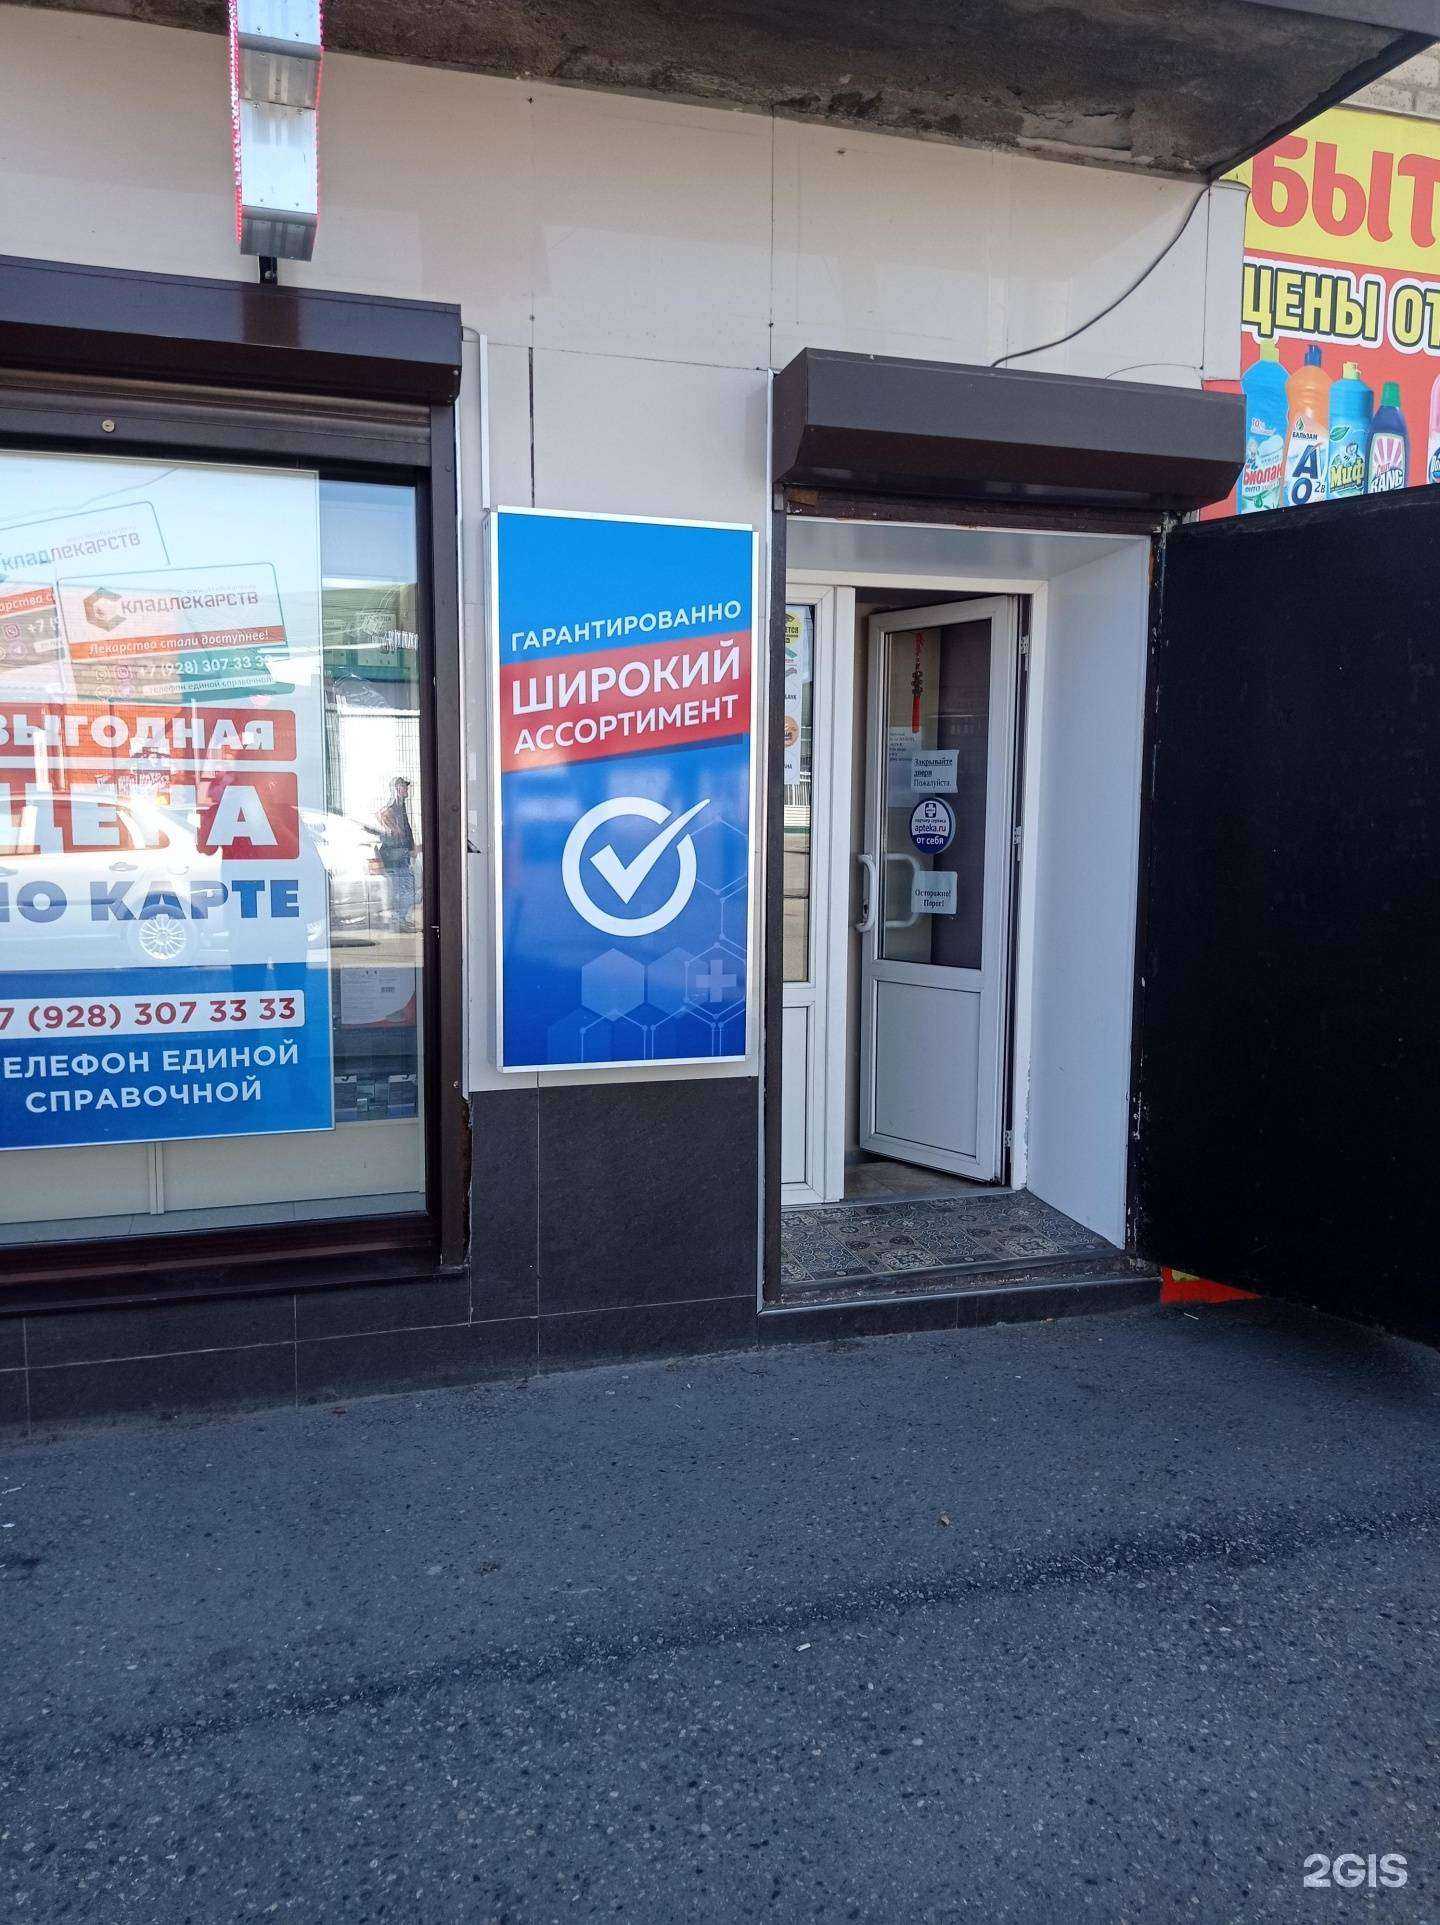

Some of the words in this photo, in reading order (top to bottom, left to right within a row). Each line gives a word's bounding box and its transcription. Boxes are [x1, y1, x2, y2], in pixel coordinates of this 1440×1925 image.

[1241, 262, 1381, 342] ЦЕНЫ
[511, 600, 742, 652] ГАРАНТИРОВАННО
[203, 658, 229, 673] 307
[512, 638, 740, 716] ШИРОКИЙ
[513, 694, 739, 755] АССОРТИМЕНТ
[914, 824, 947, 833] apteka.ru
[926, 836, 944, 845] себя
[90, 880, 300, 921] КАРТЕ
[28, 1003, 121, 1032] (928)
[134, 1001, 197, 1026] 307
[210, 1000, 247, 1023] 33
[259, 998, 296, 1020] 33
[163, 1038, 298, 1074] ЕДИНОЙ
[25, 1075, 262, 1114] СПРАВОЧНОЙ
